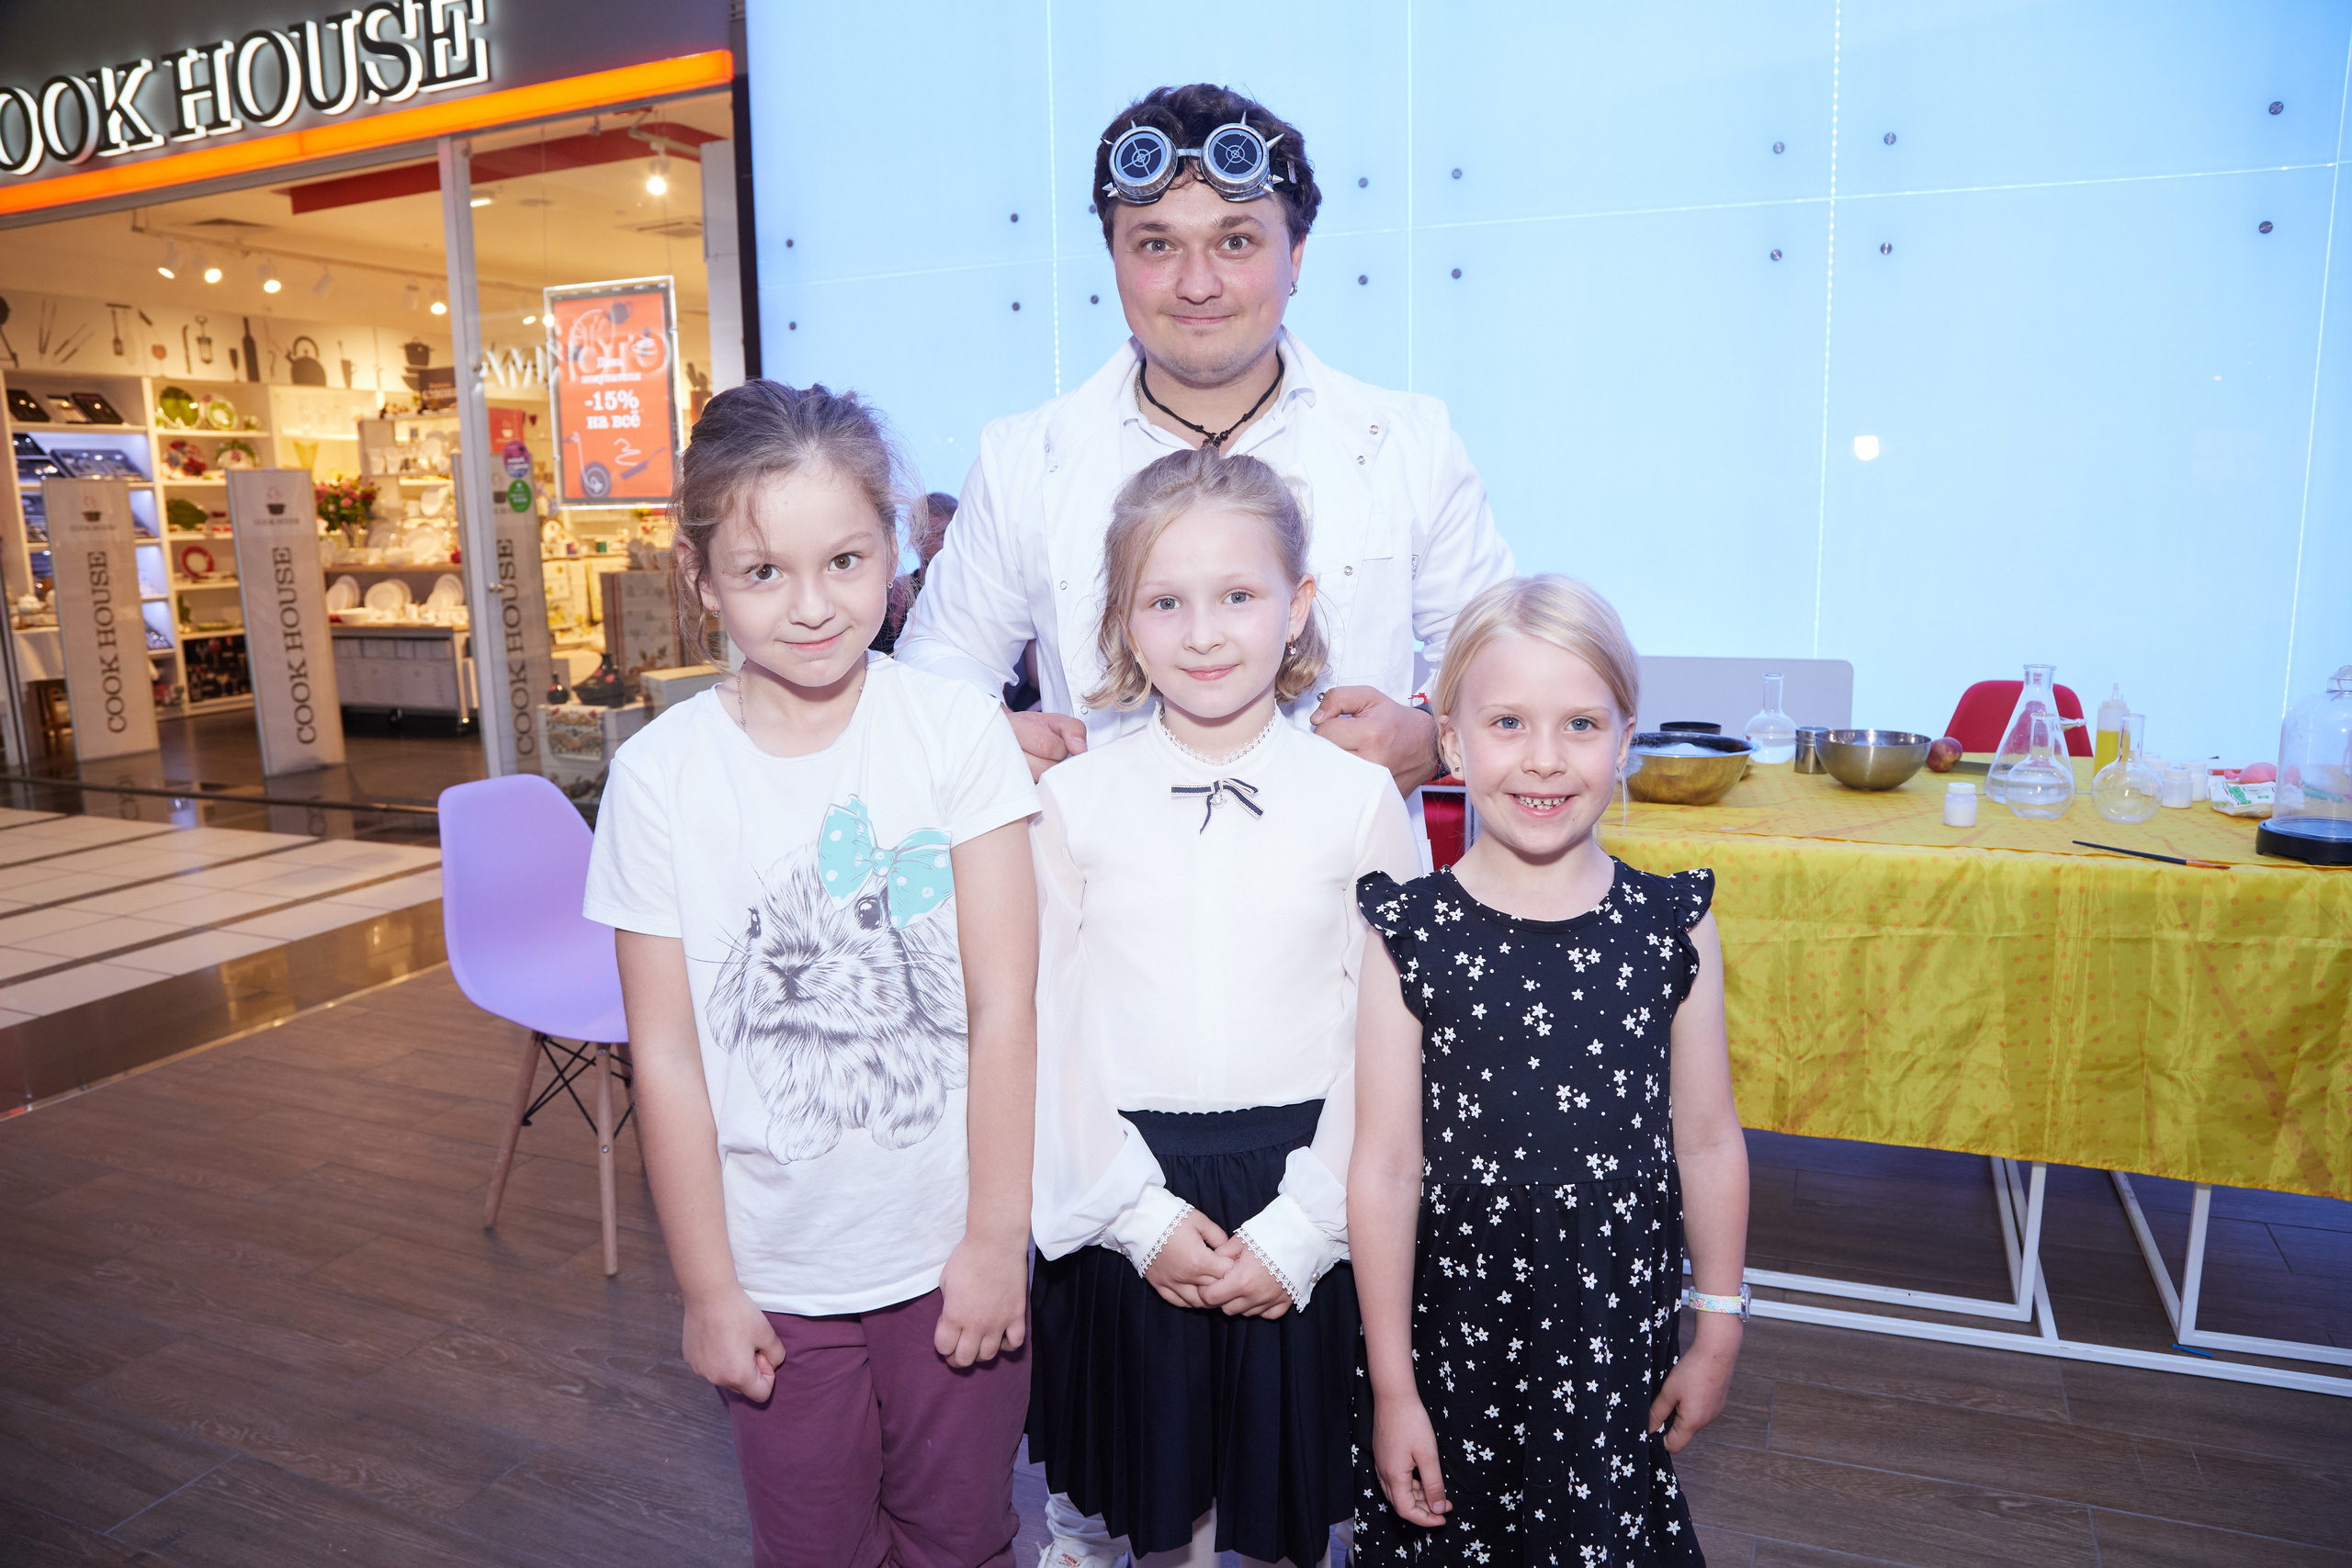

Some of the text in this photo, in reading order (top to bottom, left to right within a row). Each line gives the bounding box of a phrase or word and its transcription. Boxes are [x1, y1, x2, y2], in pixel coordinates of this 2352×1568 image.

[161, 0, 490, 142] HOUSE
[584, 389, 639, 412] -15%
[585, 410, 641, 430] на всё
[87, 550, 118, 649] HOUSE
[272, 547, 304, 653] HOUSE
[497, 538, 524, 653] HOUSE
[98, 653, 128, 734] COOK
[287, 657, 317, 746] COOK
[507, 659, 536, 756] COOK
